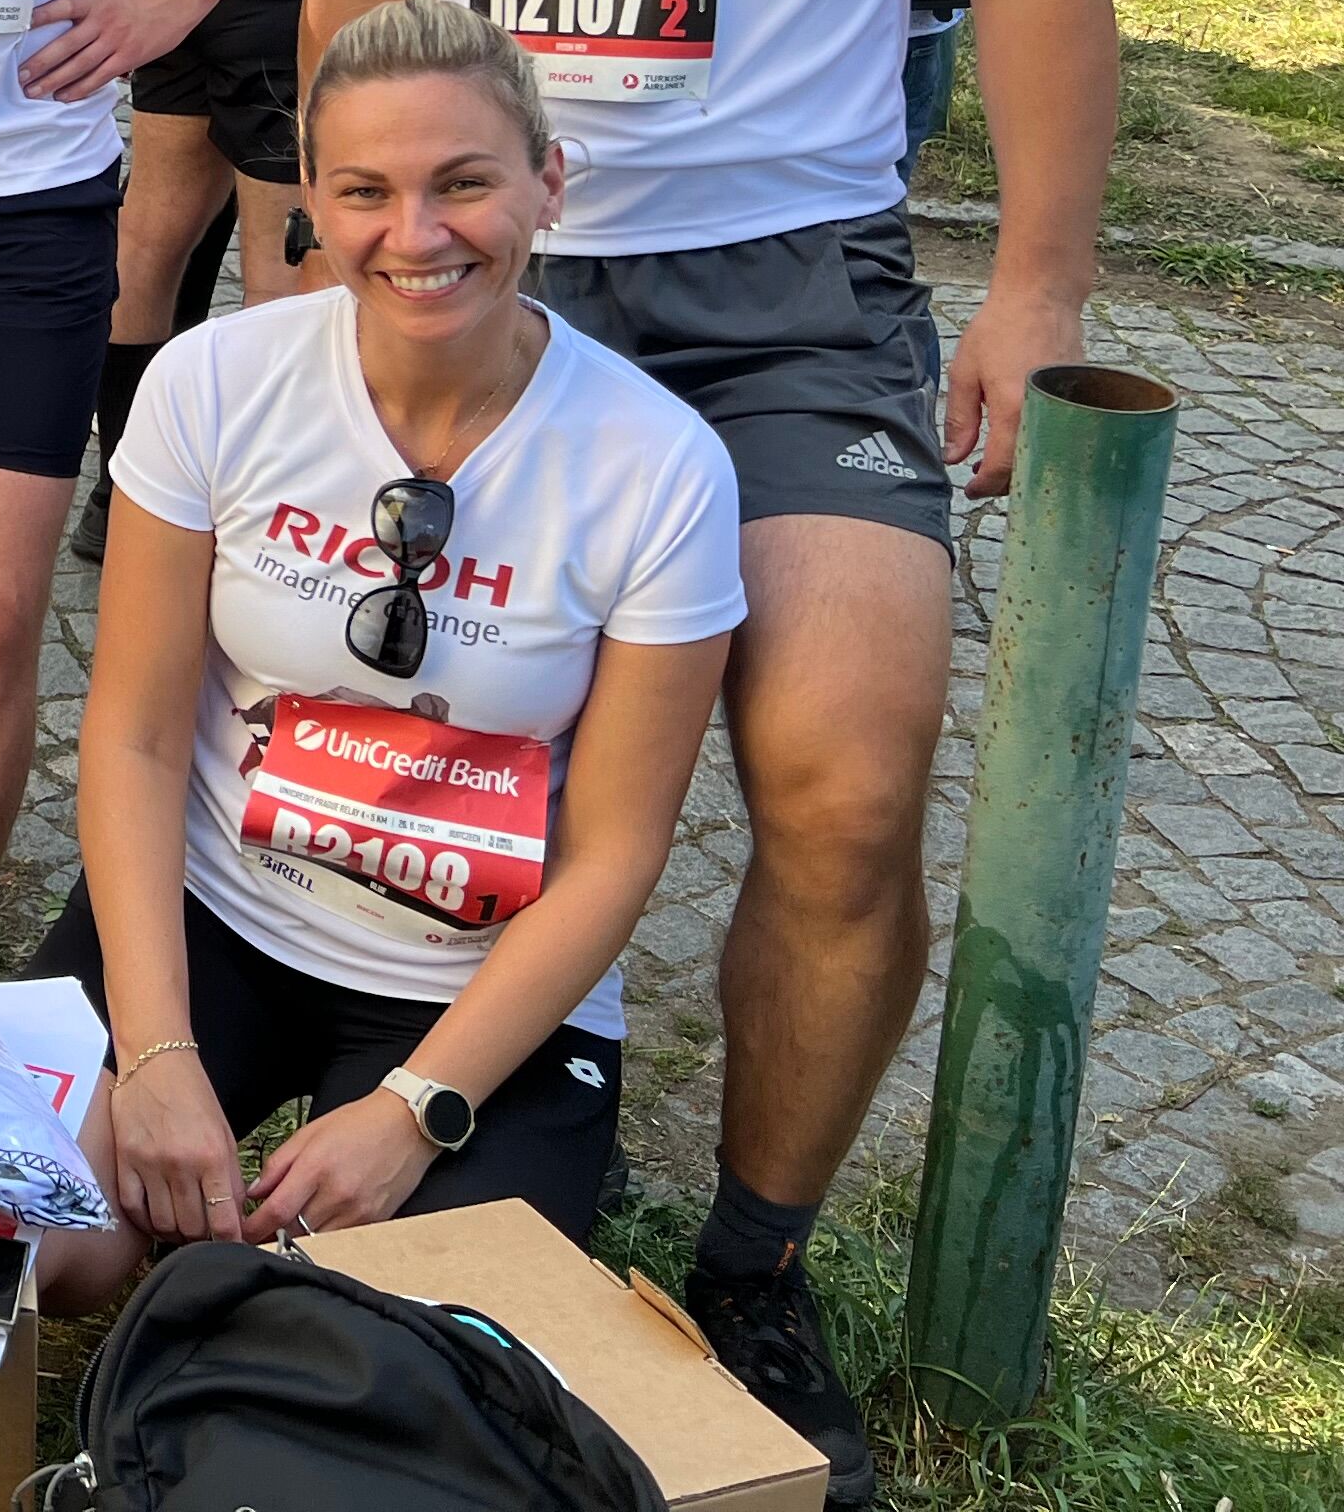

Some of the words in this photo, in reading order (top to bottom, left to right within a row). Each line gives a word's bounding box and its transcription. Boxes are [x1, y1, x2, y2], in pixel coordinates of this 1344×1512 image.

[548, 72, 593, 83] RICOH
[644, 74, 686, 83] TURKISH
[836, 451, 918, 480] adidas
[326, 727, 448, 783] UniCredit
[448, 761, 519, 798] Bank
[270, 807, 470, 913] R2108
[476, 893, 499, 921] 1
